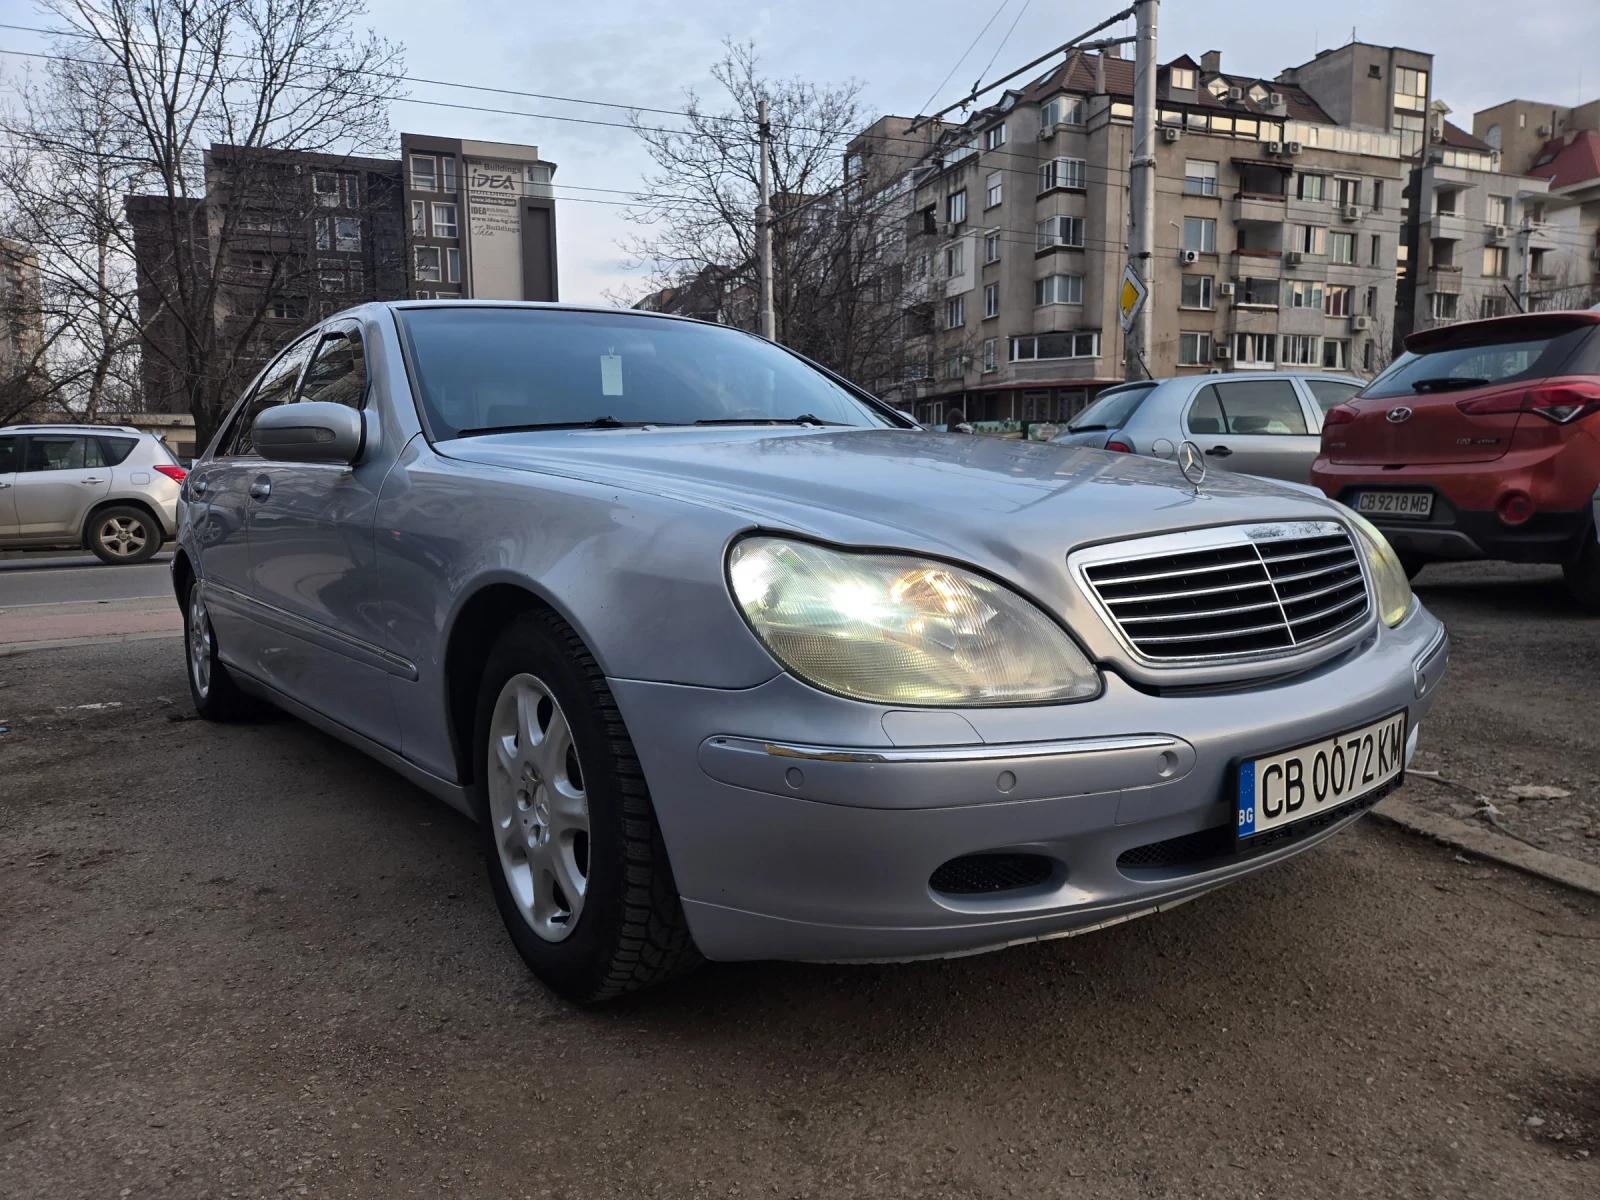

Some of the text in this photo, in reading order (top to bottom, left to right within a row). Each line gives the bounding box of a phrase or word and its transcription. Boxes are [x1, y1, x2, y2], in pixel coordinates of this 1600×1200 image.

[484, 163, 521, 174] Buildings
[471, 206, 487, 215] IDEA
[471, 217, 520, 225] www.idea-bg.net
[485, 224, 520, 233] Buildings
[1378, 495, 1409, 511] 9218
[1312, 733, 1374, 802] 0072
[1238, 807, 1254, 826] BG
